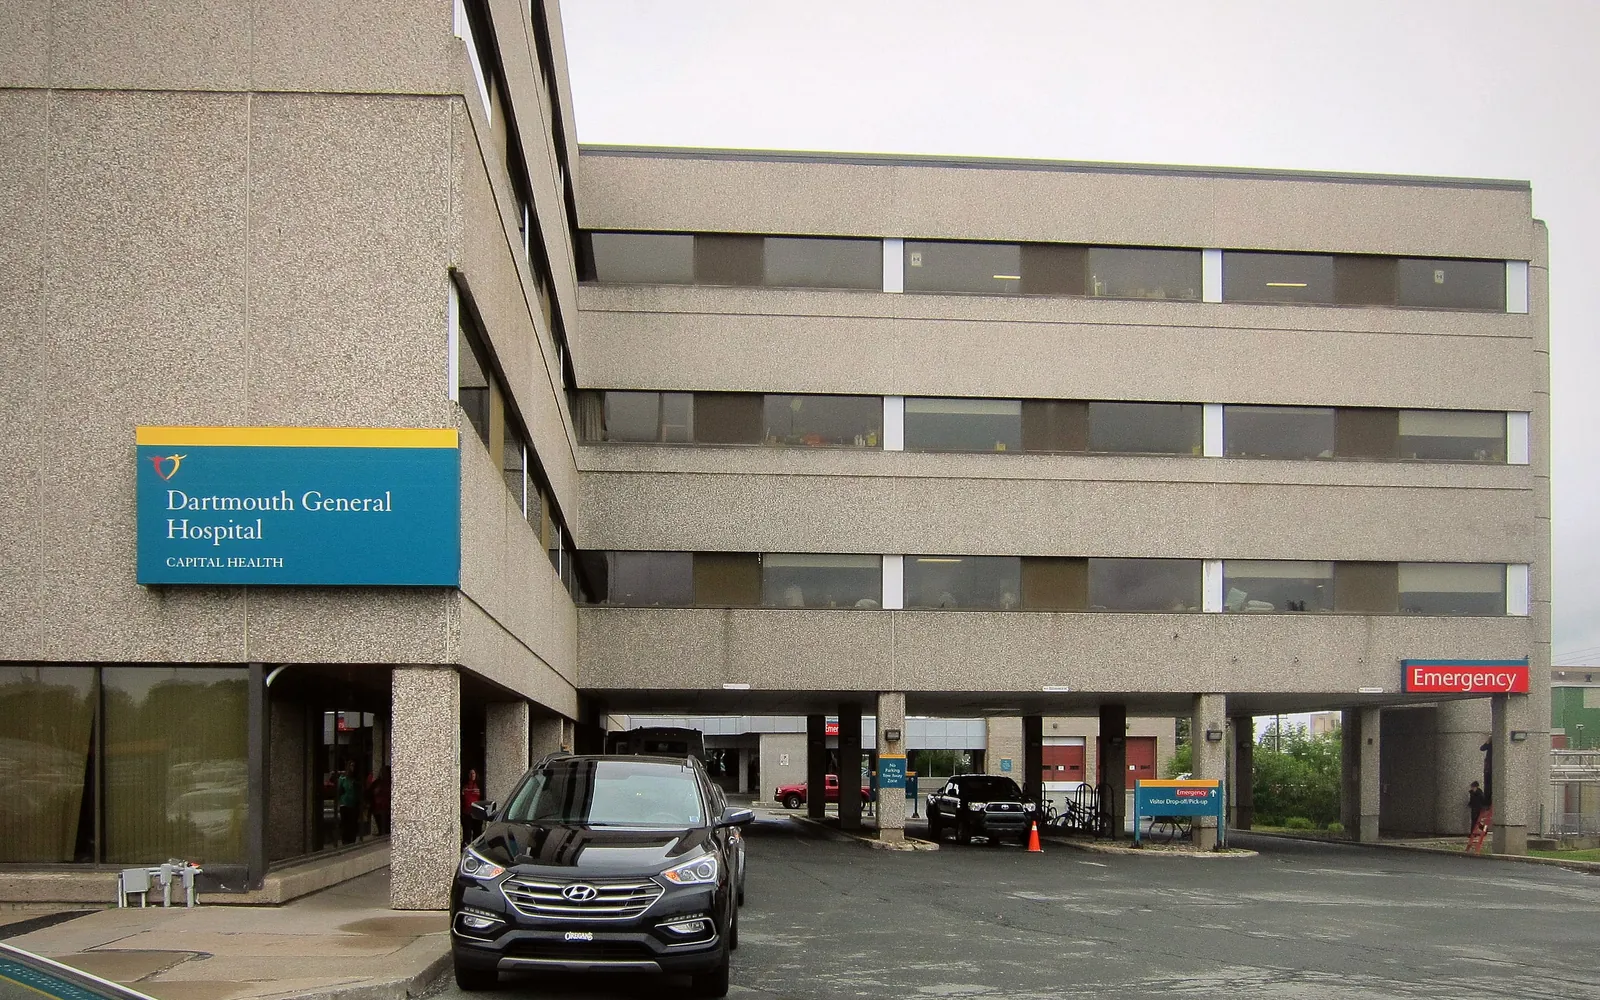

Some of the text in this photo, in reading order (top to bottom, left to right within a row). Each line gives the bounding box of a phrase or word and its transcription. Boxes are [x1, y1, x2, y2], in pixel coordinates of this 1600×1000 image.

[166, 489, 392, 512] Dartmouth General
[166, 518, 263, 546] Hospital
[166, 557, 284, 568] CAPITAL HEALTH
[1413, 668, 1517, 692] Emergency
[1176, 789, 1207, 797] Emergency
